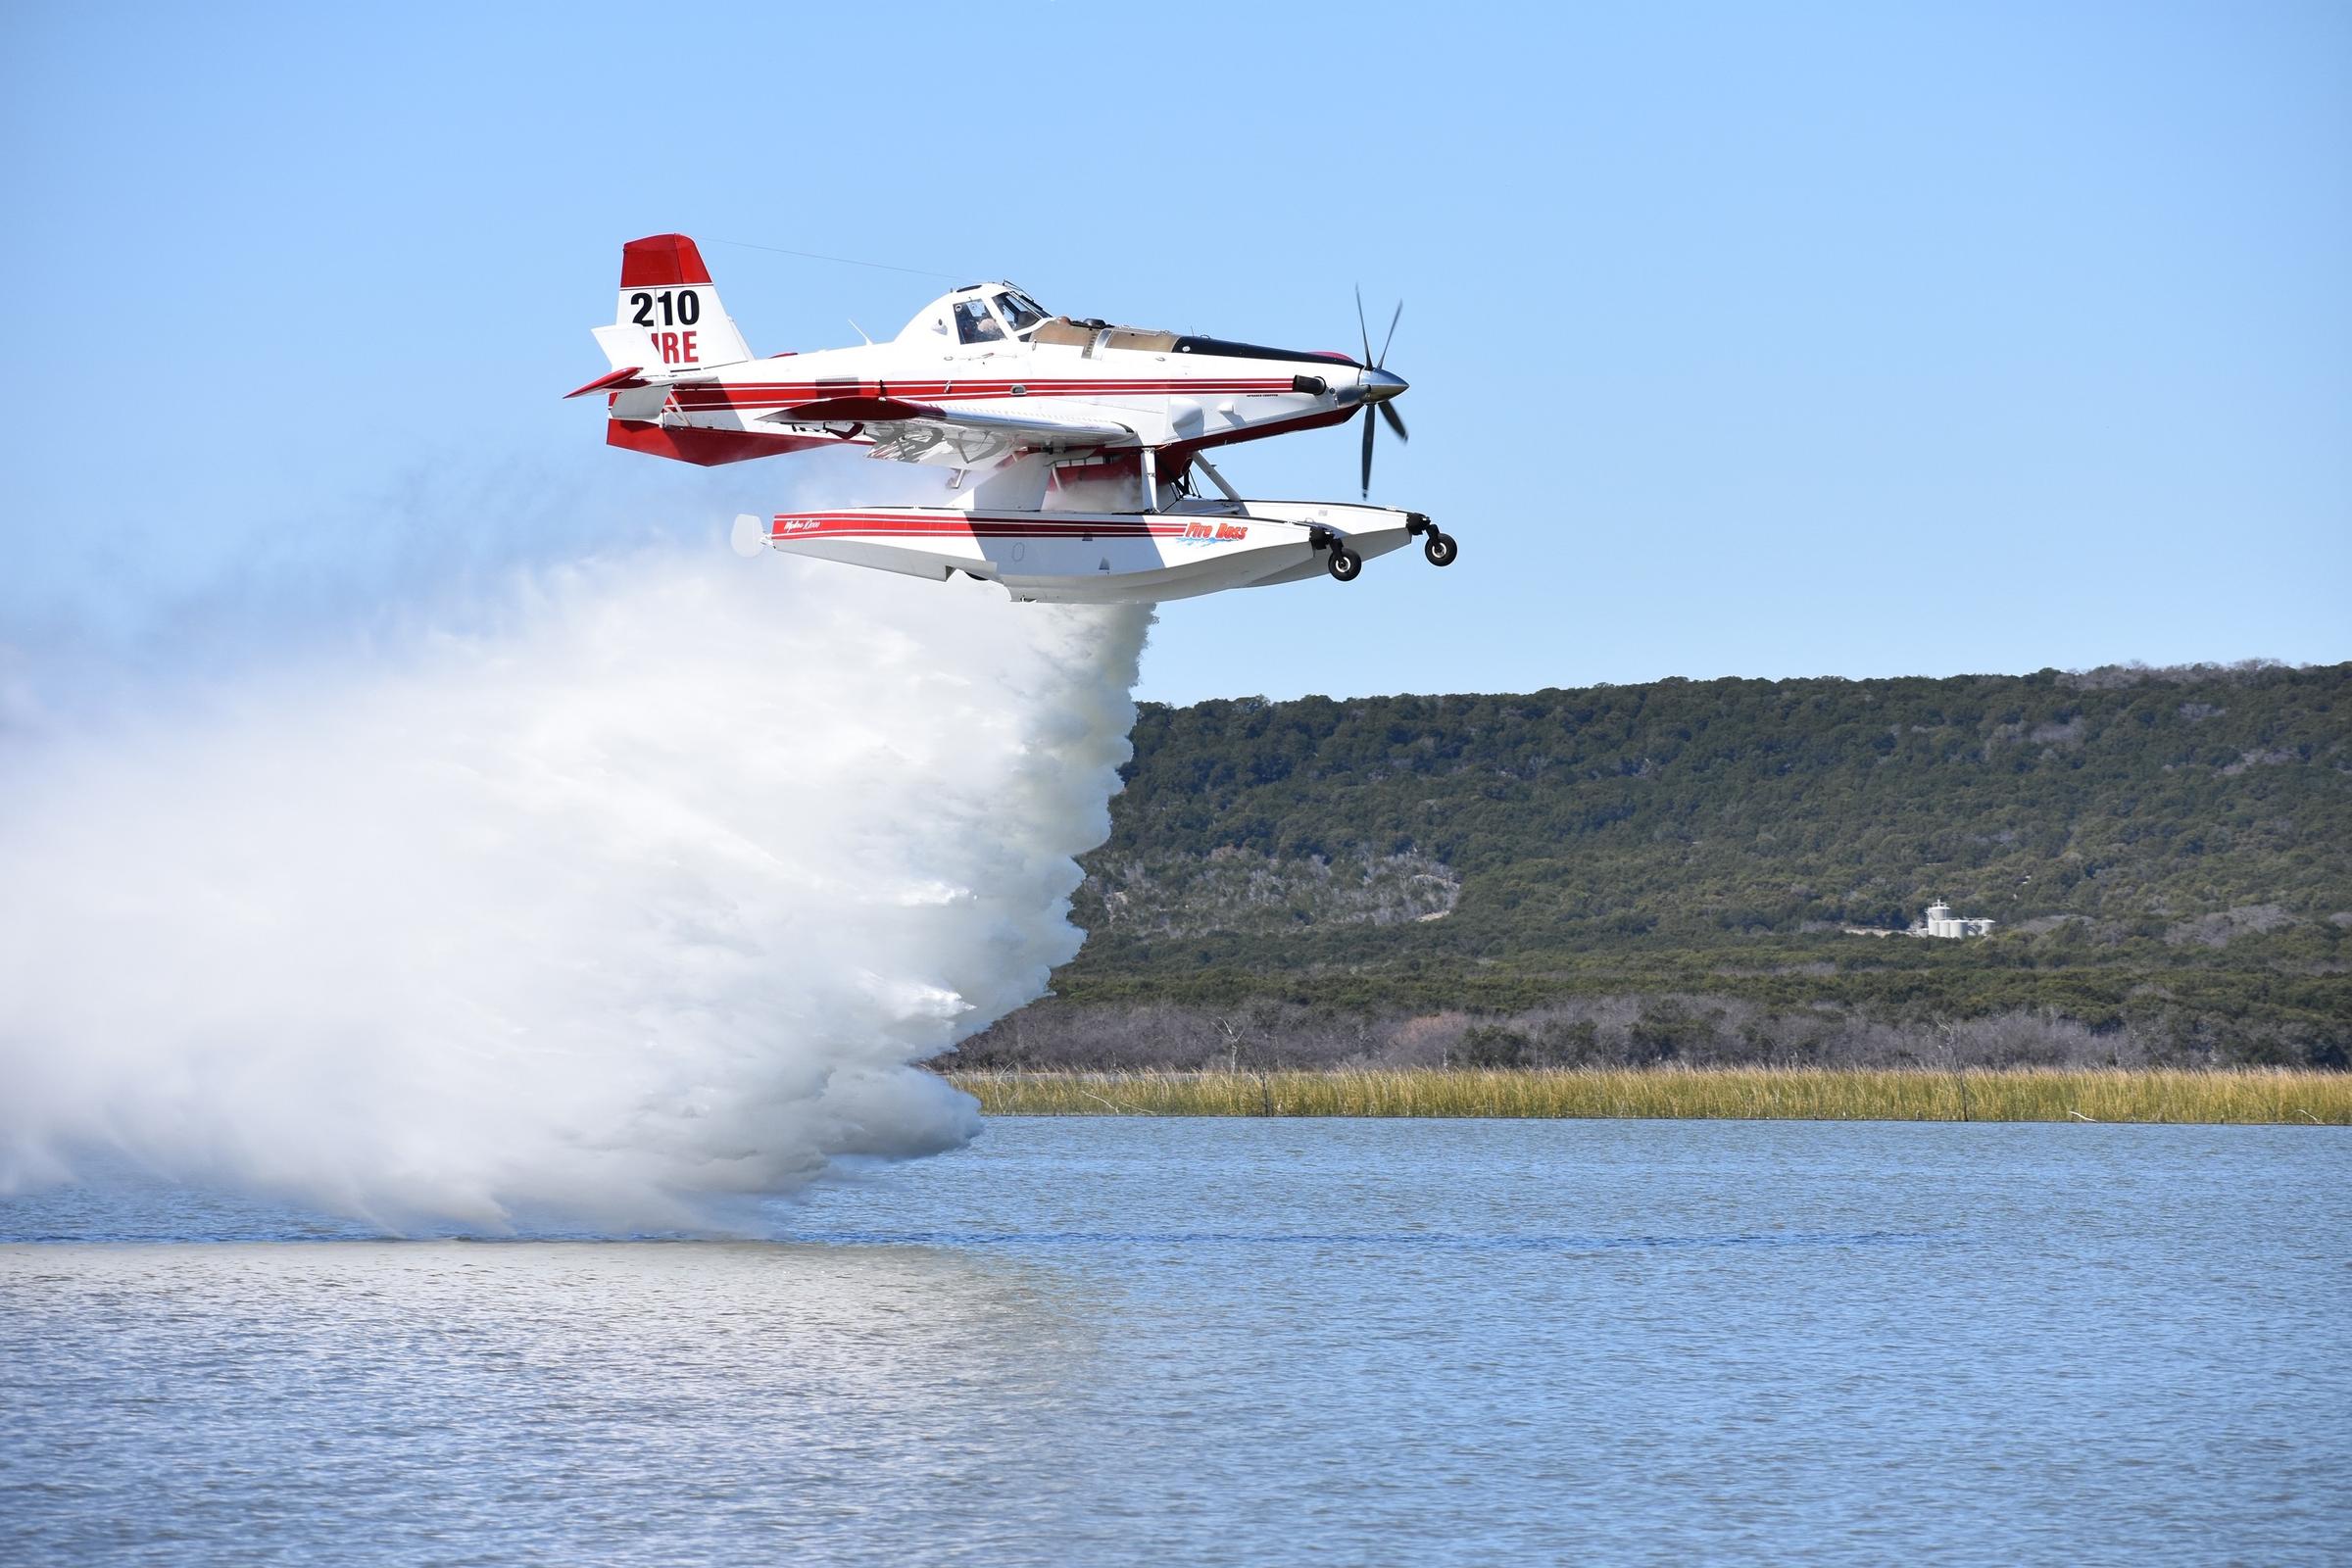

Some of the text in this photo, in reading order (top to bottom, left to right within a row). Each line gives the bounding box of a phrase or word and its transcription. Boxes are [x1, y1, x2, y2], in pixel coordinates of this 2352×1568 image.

[630, 290, 700, 326] 210
[1185, 522, 1248, 540] Fire Boss
